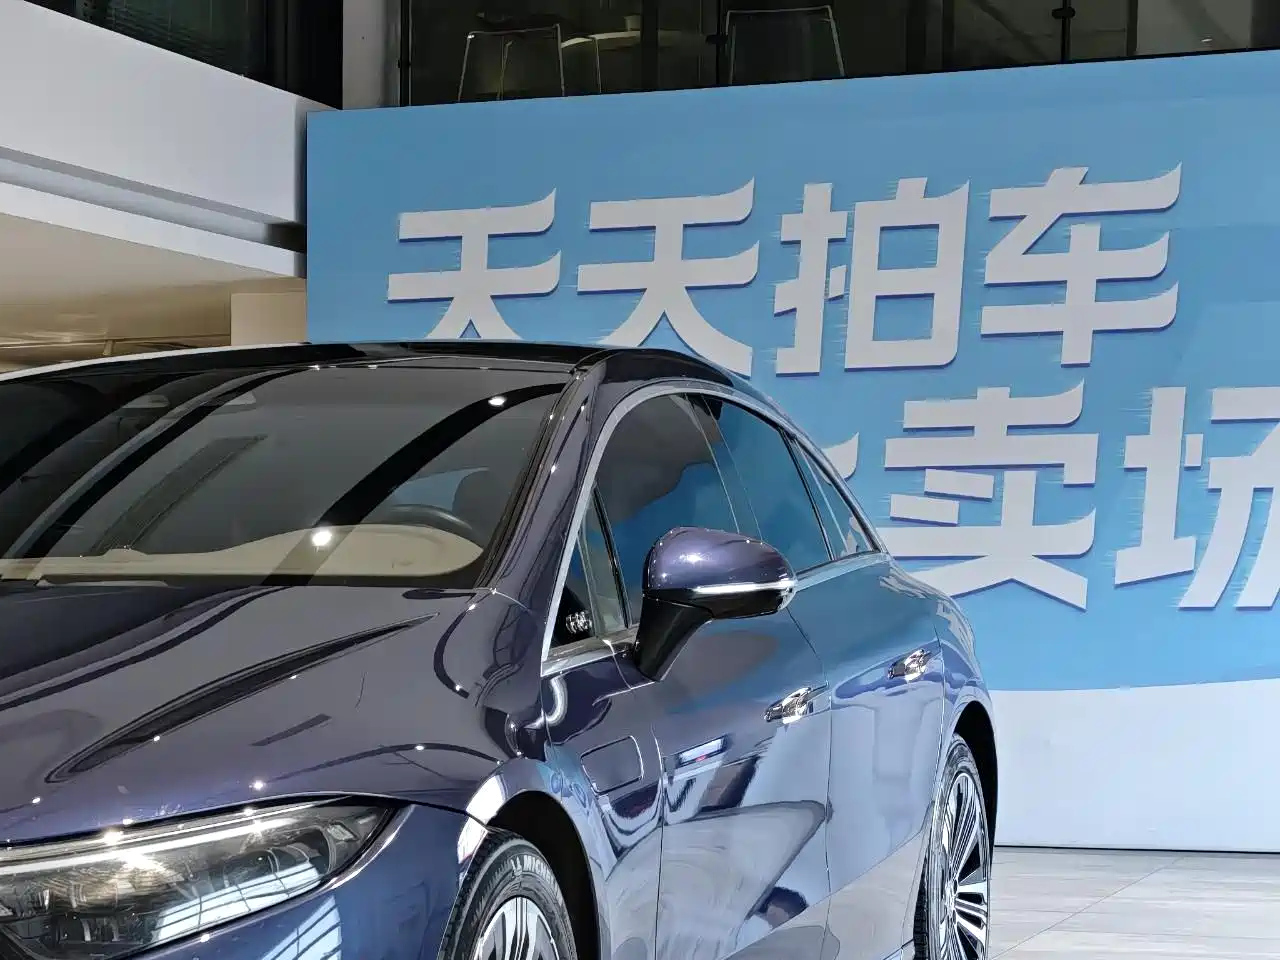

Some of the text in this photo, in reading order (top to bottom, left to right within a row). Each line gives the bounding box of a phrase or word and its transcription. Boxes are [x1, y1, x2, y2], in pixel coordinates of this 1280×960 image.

[387, 161, 1182, 376] 天天拍车
[820, 377, 1280, 611] 卖场
